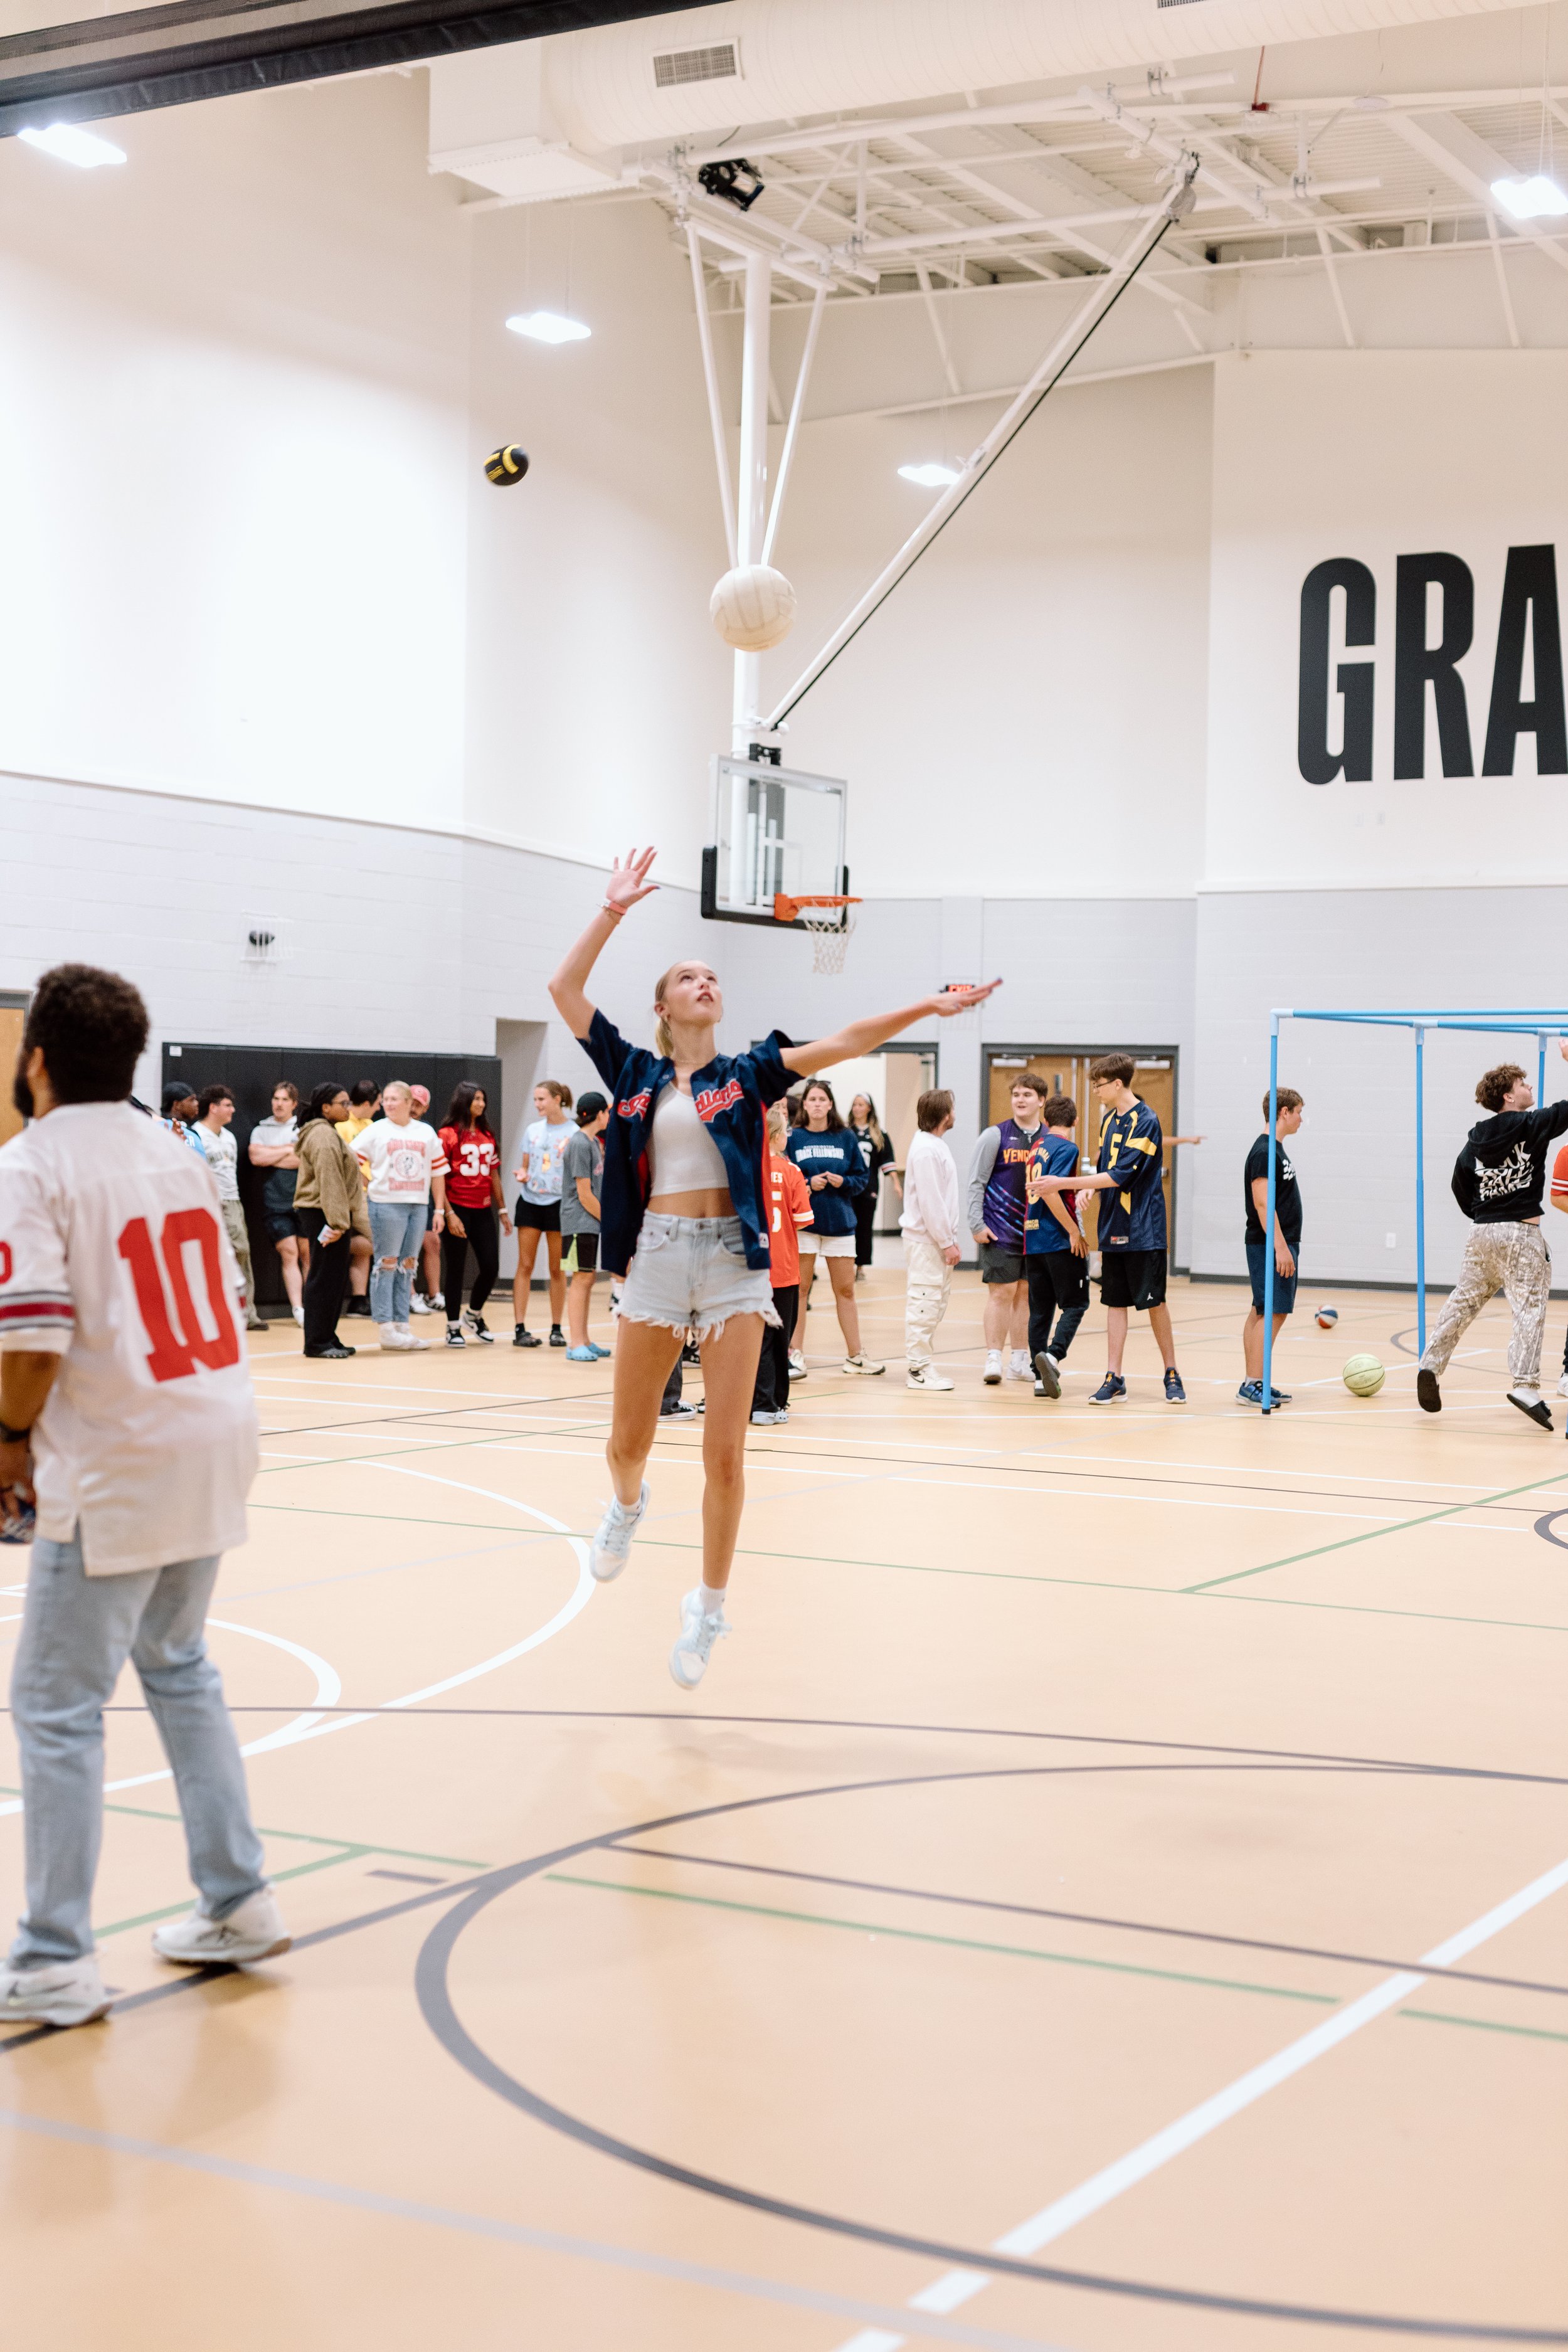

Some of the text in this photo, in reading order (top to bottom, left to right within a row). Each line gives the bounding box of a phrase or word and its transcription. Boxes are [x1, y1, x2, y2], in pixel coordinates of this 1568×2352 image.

[1298, 543, 1568, 785] GRA
[460, 1143, 494, 1177] 33
[118, 1207, 240, 1382] 10
